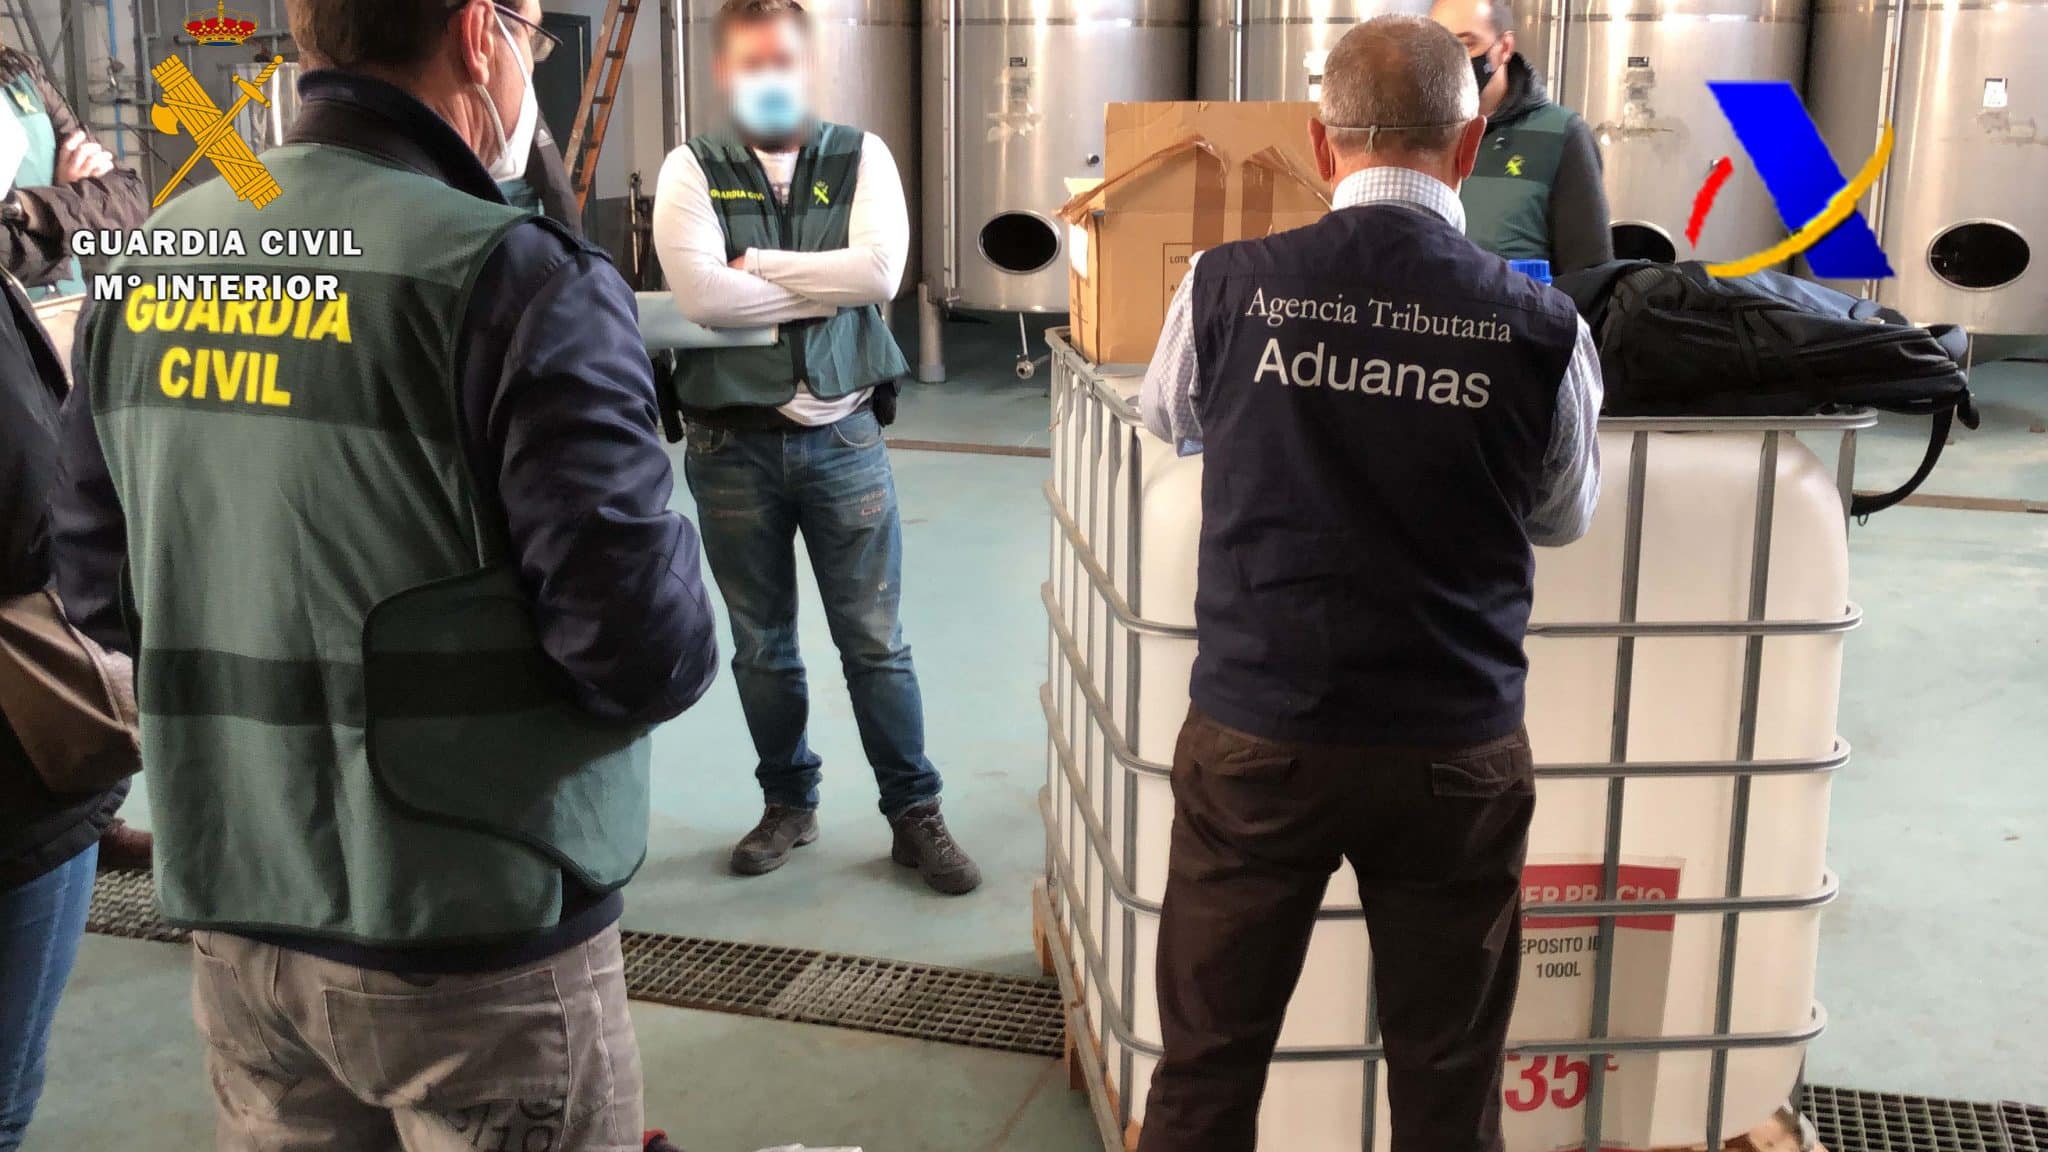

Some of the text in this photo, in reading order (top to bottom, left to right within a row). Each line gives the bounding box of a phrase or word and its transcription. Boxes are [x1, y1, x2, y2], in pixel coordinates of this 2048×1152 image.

[125, 283, 353, 344] GUARDIA
[1245, 287, 1513, 343] Agencia Tributaria
[159, 346, 292, 407] CIVIL
[1253, 337, 1492, 409] Aduanas
[1536, 961, 1582, 978] 1000L
[1504, 1053, 1591, 1112] 35
